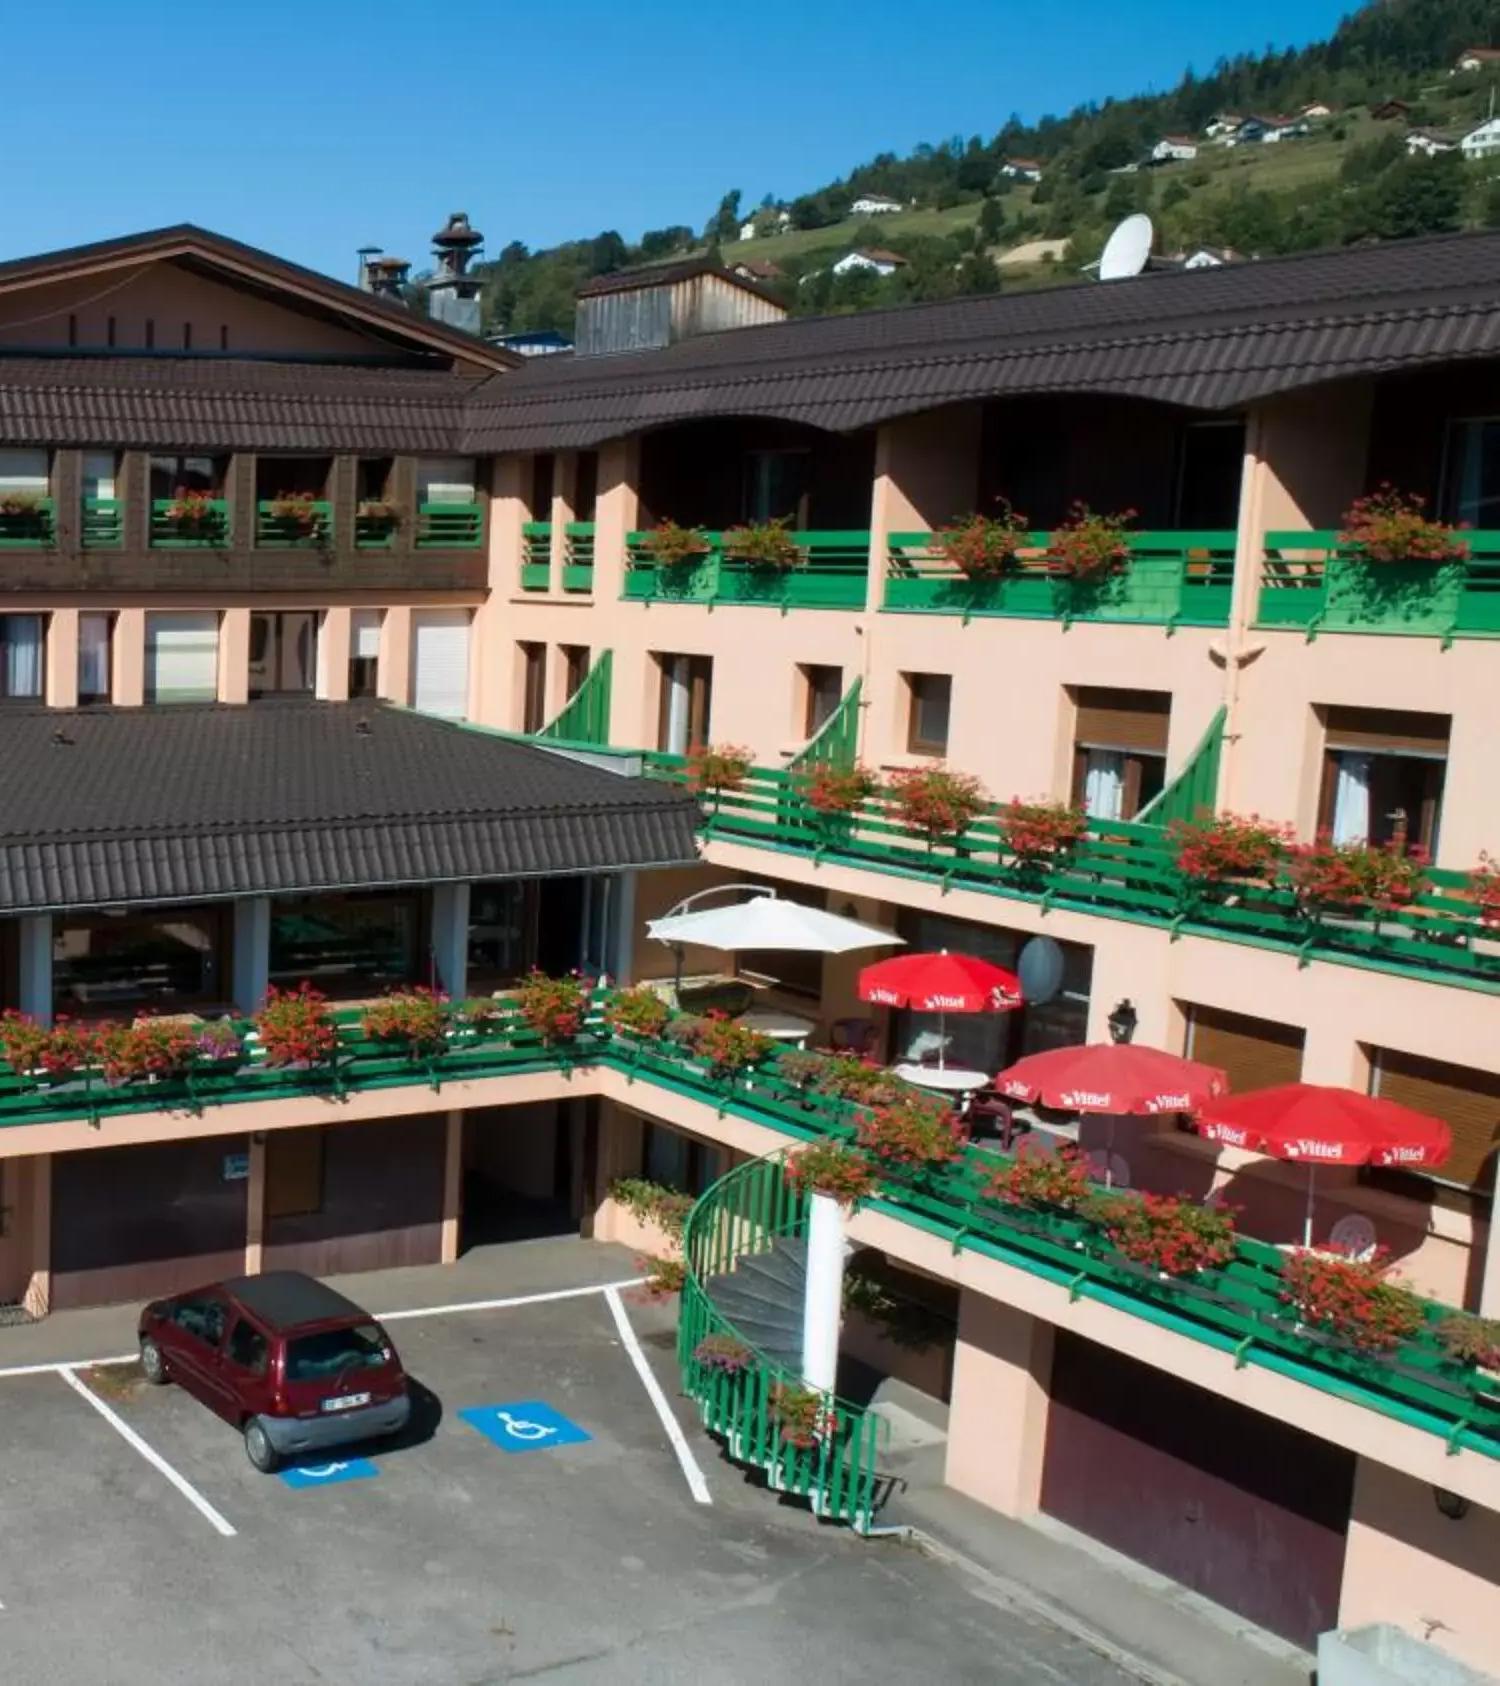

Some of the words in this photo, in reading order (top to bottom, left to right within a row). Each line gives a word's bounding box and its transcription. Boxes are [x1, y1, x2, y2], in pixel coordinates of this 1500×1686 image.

[1073, 1090, 1110, 1106] Vittel
[1156, 1093, 1189, 1109] Vittel
[1216, 1123, 1245, 1145] Vittel
[1298, 1139, 1343, 1158] Vittel
[1392, 1145, 1425, 1162] Vittel
